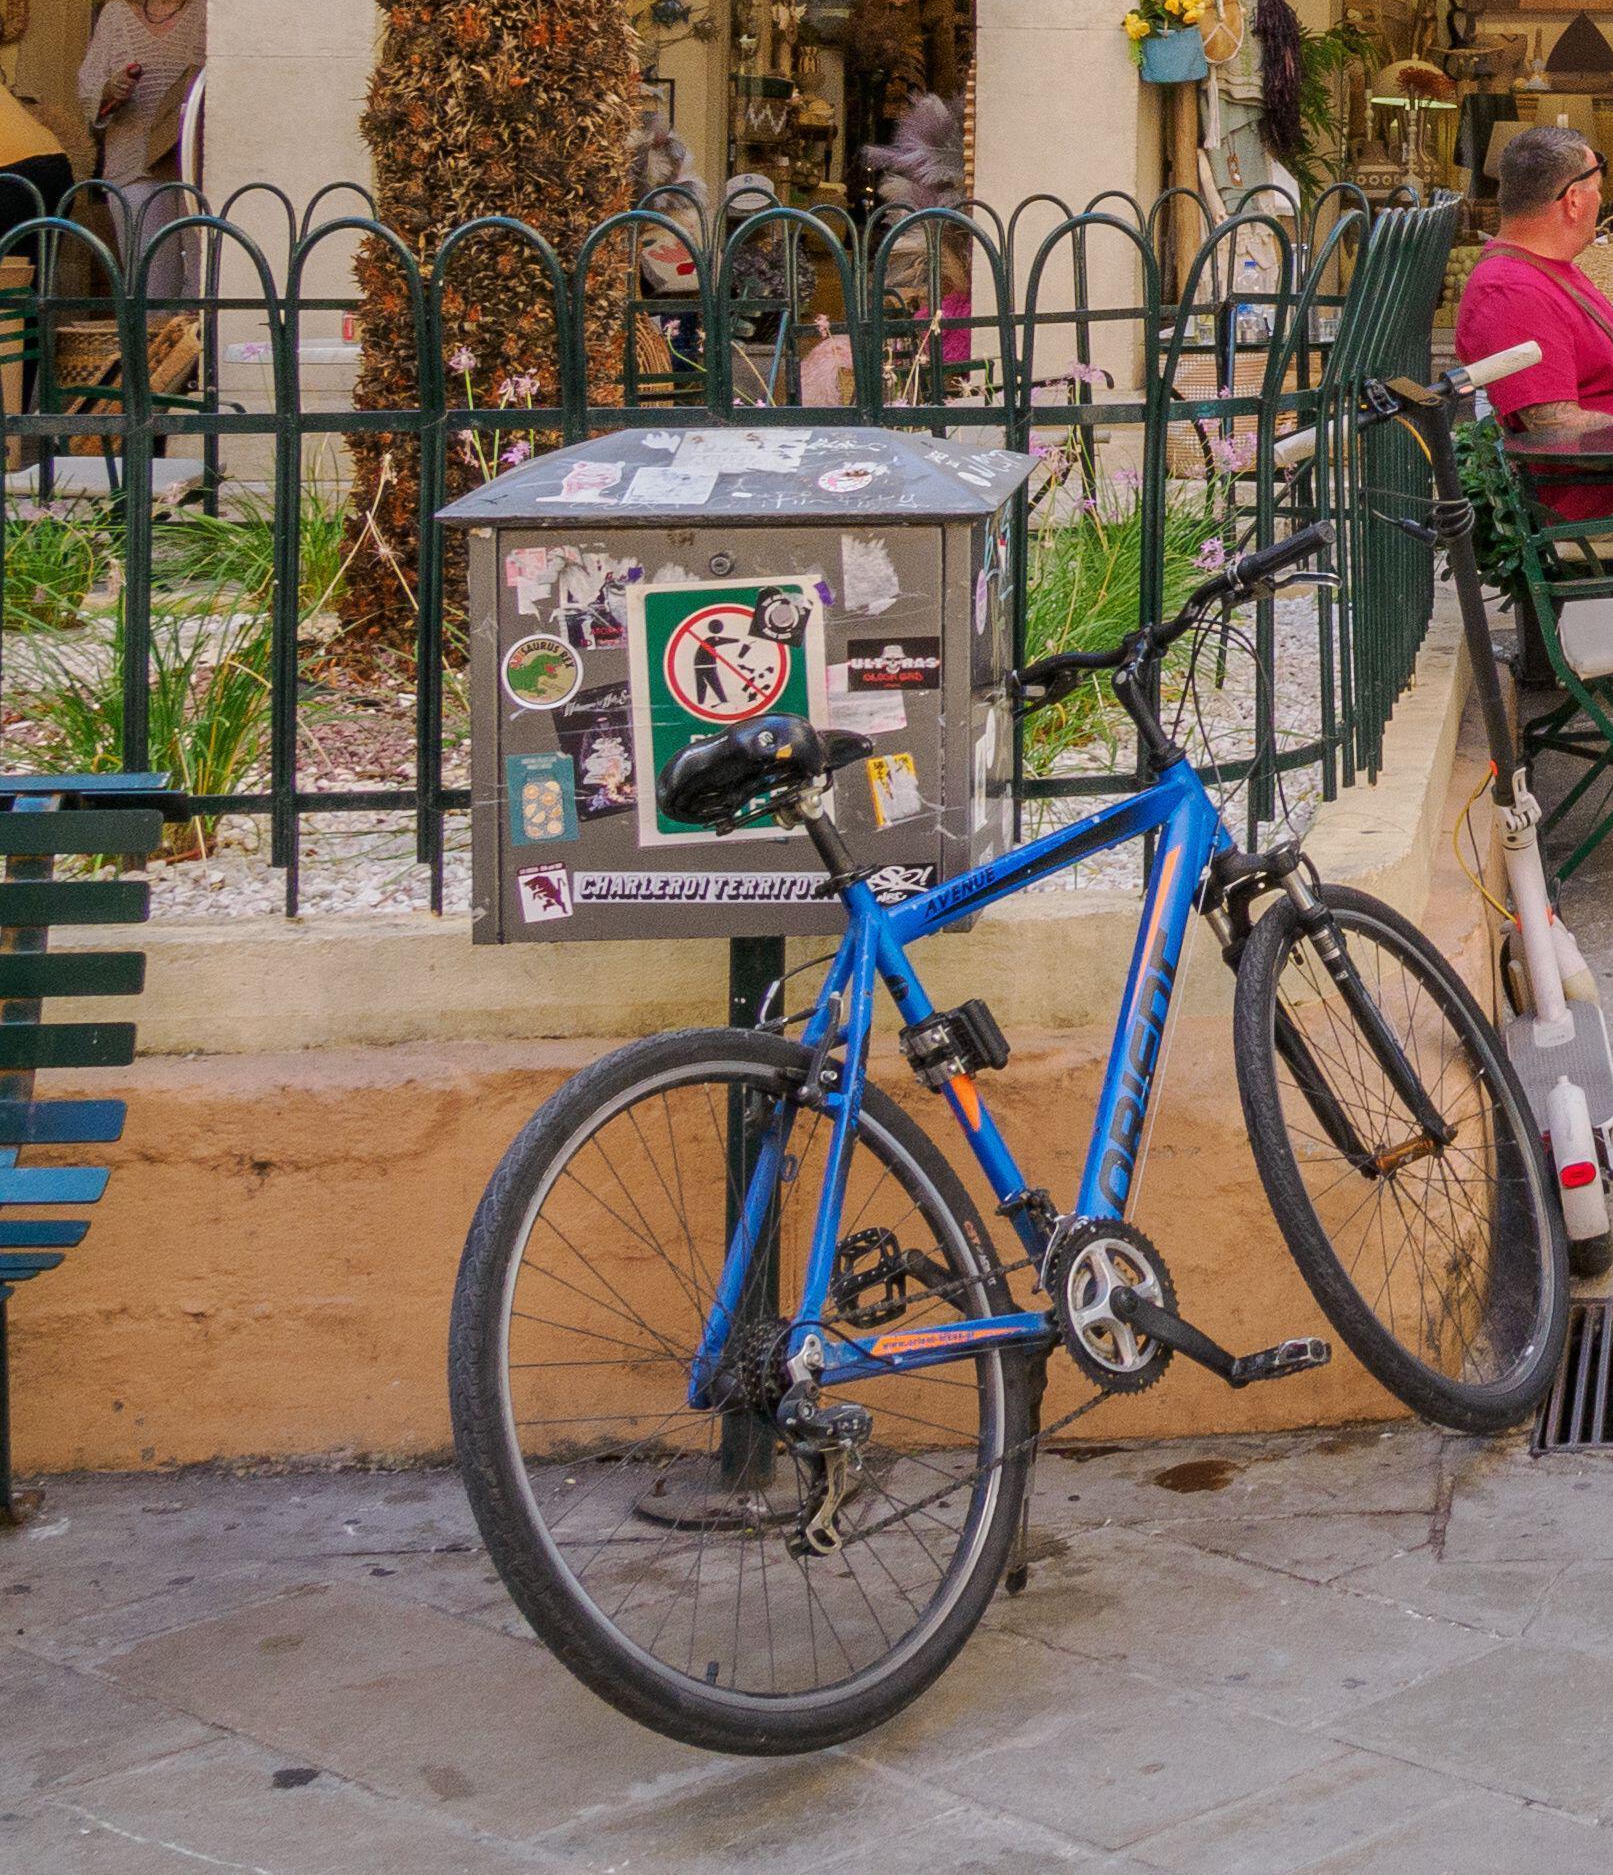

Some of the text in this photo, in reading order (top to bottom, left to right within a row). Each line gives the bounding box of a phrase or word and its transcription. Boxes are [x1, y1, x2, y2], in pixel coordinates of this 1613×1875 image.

[579, 875, 708, 901] CHARLEROI
[713, 875, 836, 901] TERRITOR
[924, 867, 998, 919] AVENUE
[1099, 926, 1177, 1214] ORIENT
